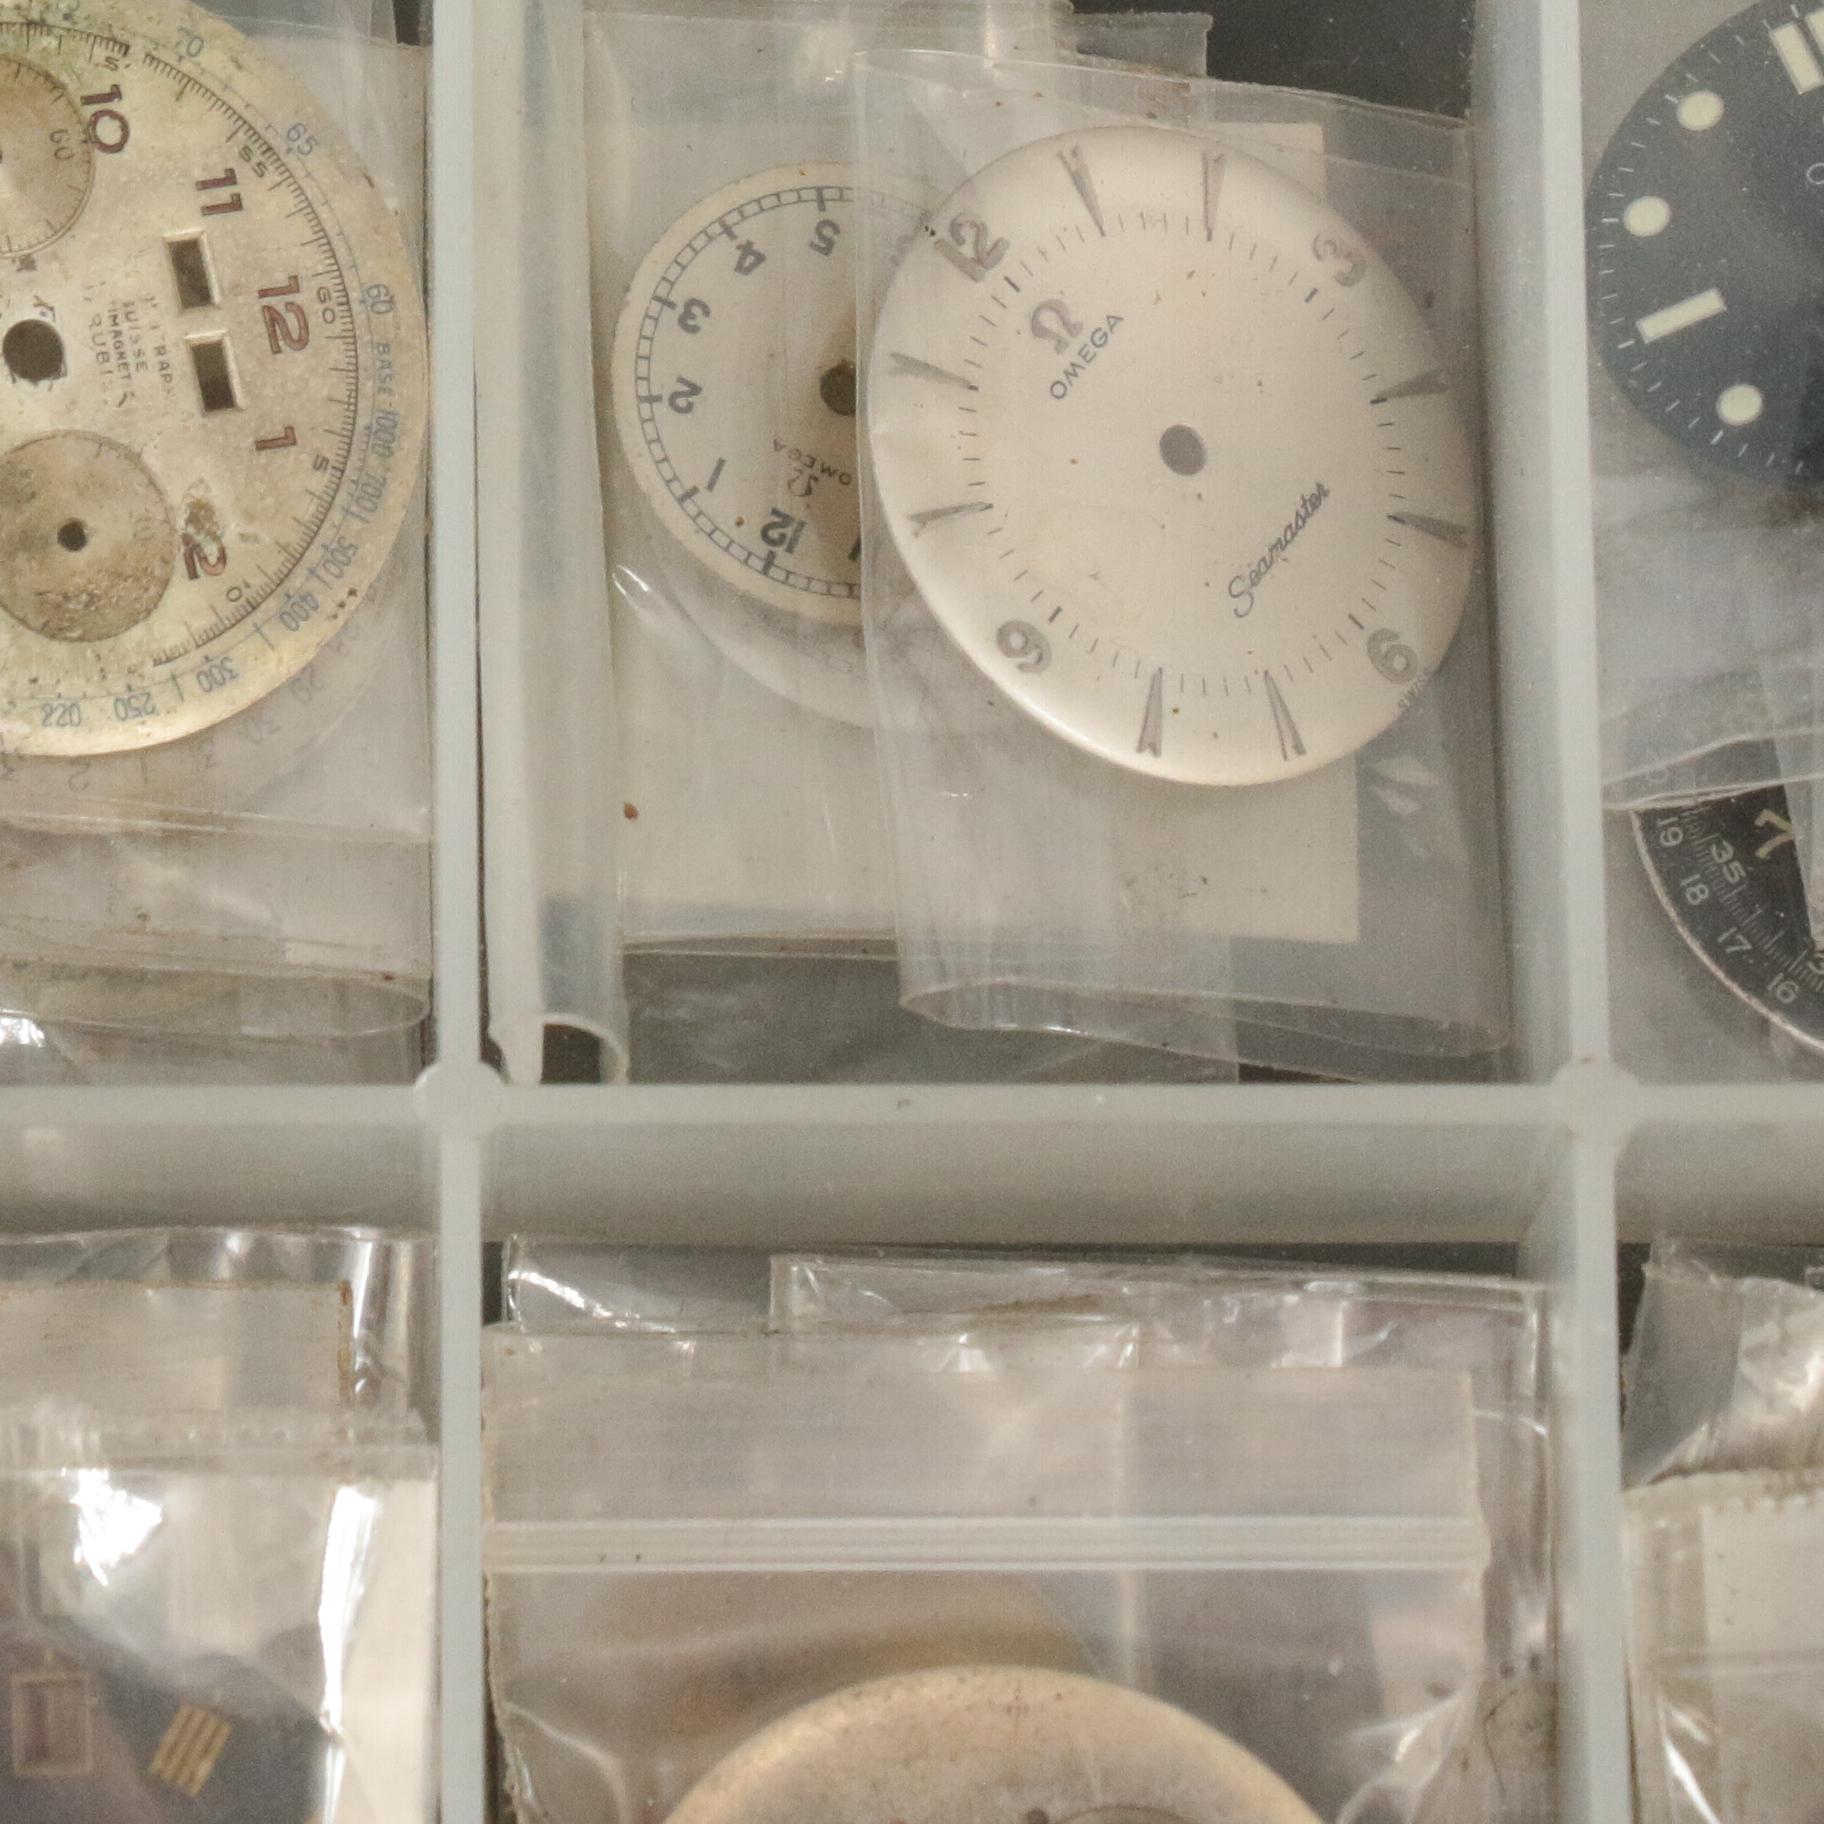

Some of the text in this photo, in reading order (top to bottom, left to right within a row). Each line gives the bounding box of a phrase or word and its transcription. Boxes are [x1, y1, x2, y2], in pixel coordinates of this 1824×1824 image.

[176, 27, 207, 59] 70
[79, 82, 131, 155] 10
[285, 121, 319, 157] 65
[237, 146, 270, 179] 55
[194, 167, 244, 217] 11
[808, 218, 841, 257] 5
[933, 212, 1011, 283] 12
[733, 239, 767, 277] 4
[257, 274, 311, 355] 12
[316, 286, 337, 326] 60
[365, 282, 396, 316] 60
[677, 297, 711, 335] 3
[1049, 313, 1125, 400] OMEGA
[667, 376, 704, 415] 2
[254, 424, 298, 453] 1
[312, 454, 331, 472] 5
[706, 457, 727, 493] 1
[772, 437, 853, 487] OMEGA
[759, 507, 808, 555] 12
[1227, 481, 1330, 619] Seamaster
[325, 535, 360, 580] 500
[226, 580, 253, 604] 10
[278, 591, 320, 633] 400
[995, 619, 1051, 675] 9
[1366, 627, 1419, 686] 6
[195, 656, 241, 694] 300
[40, 702, 84, 728] 220
[113, 692, 158, 722] 250
[1656, 816, 1685, 848] 19
[1754, 808, 1795, 860] 7
[1710, 840, 1748, 885] 35
[1679, 873, 1710, 906] 18
[1717, 926, 1752, 956] 17
[1767, 971, 1800, 1004] 16
